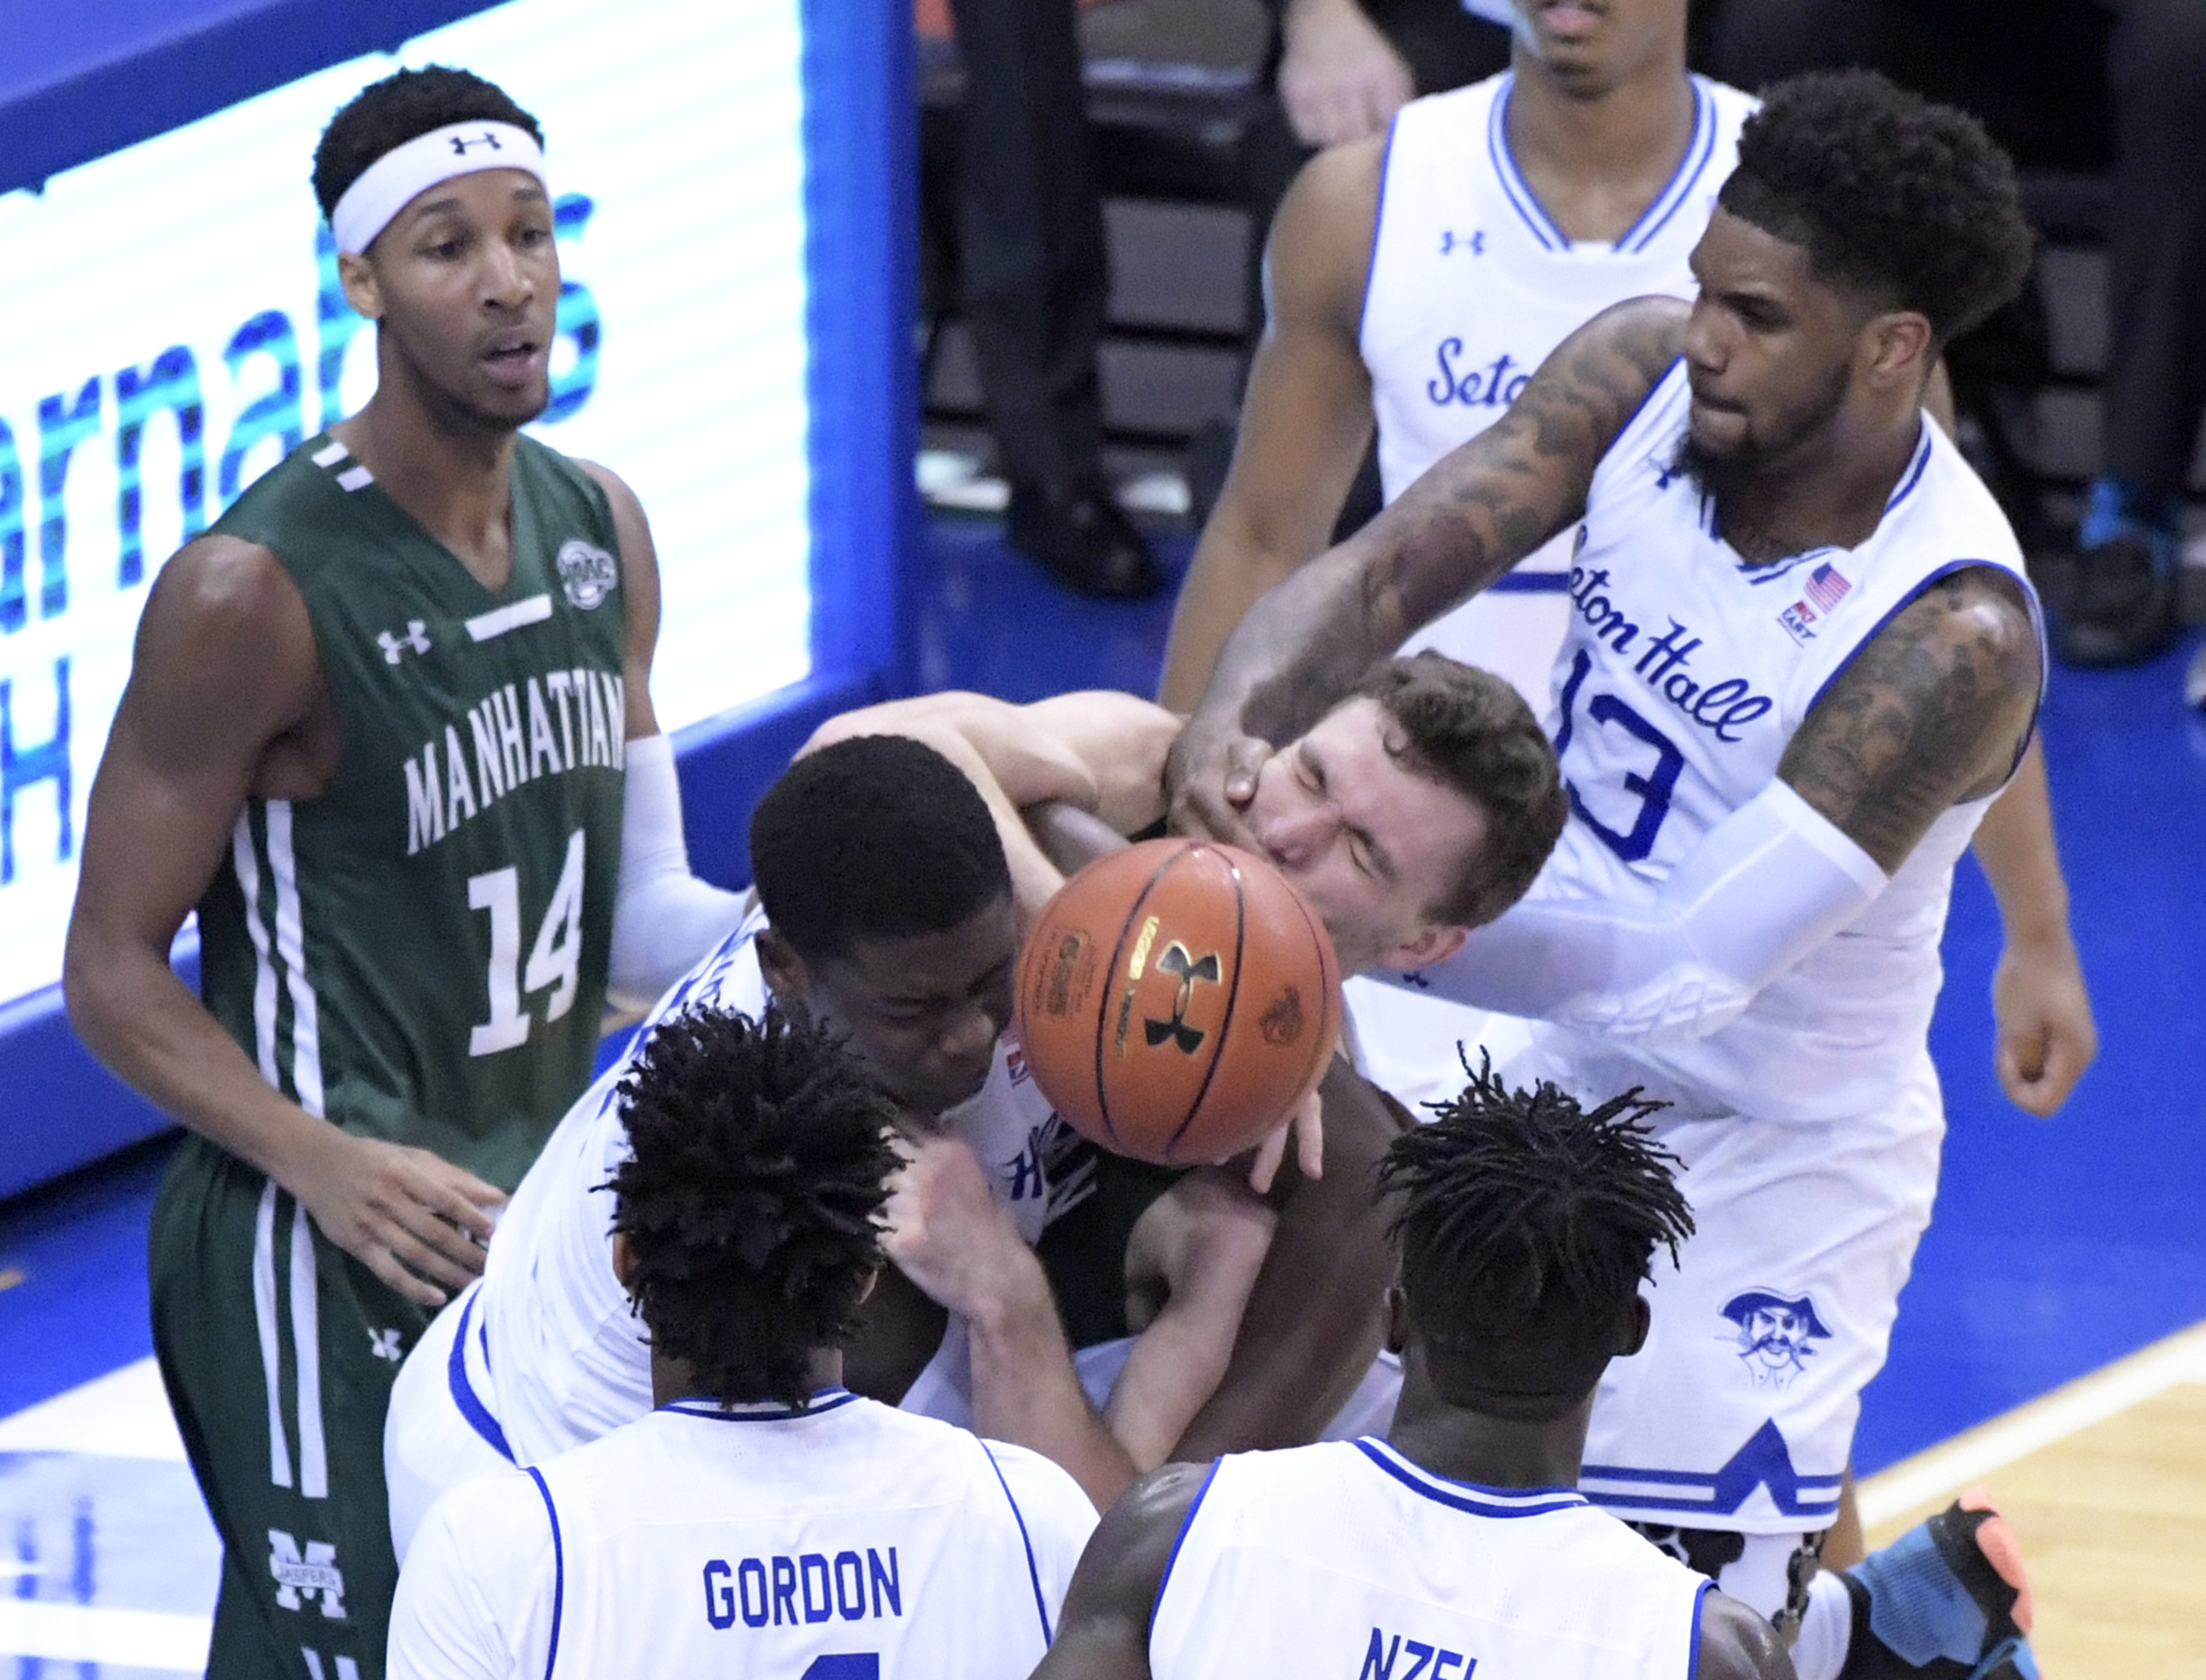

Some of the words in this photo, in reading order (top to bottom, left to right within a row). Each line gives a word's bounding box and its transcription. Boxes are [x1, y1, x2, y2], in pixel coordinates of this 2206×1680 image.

[1570, 547, 1639, 654] eton
[1635, 615, 1772, 742] Hall
[404, 668, 626, 854] MANHATTAN
[1554, 648, 1684, 861] 13
[468, 828, 585, 1057] 14
[703, 1546, 902, 1630] GORDON
